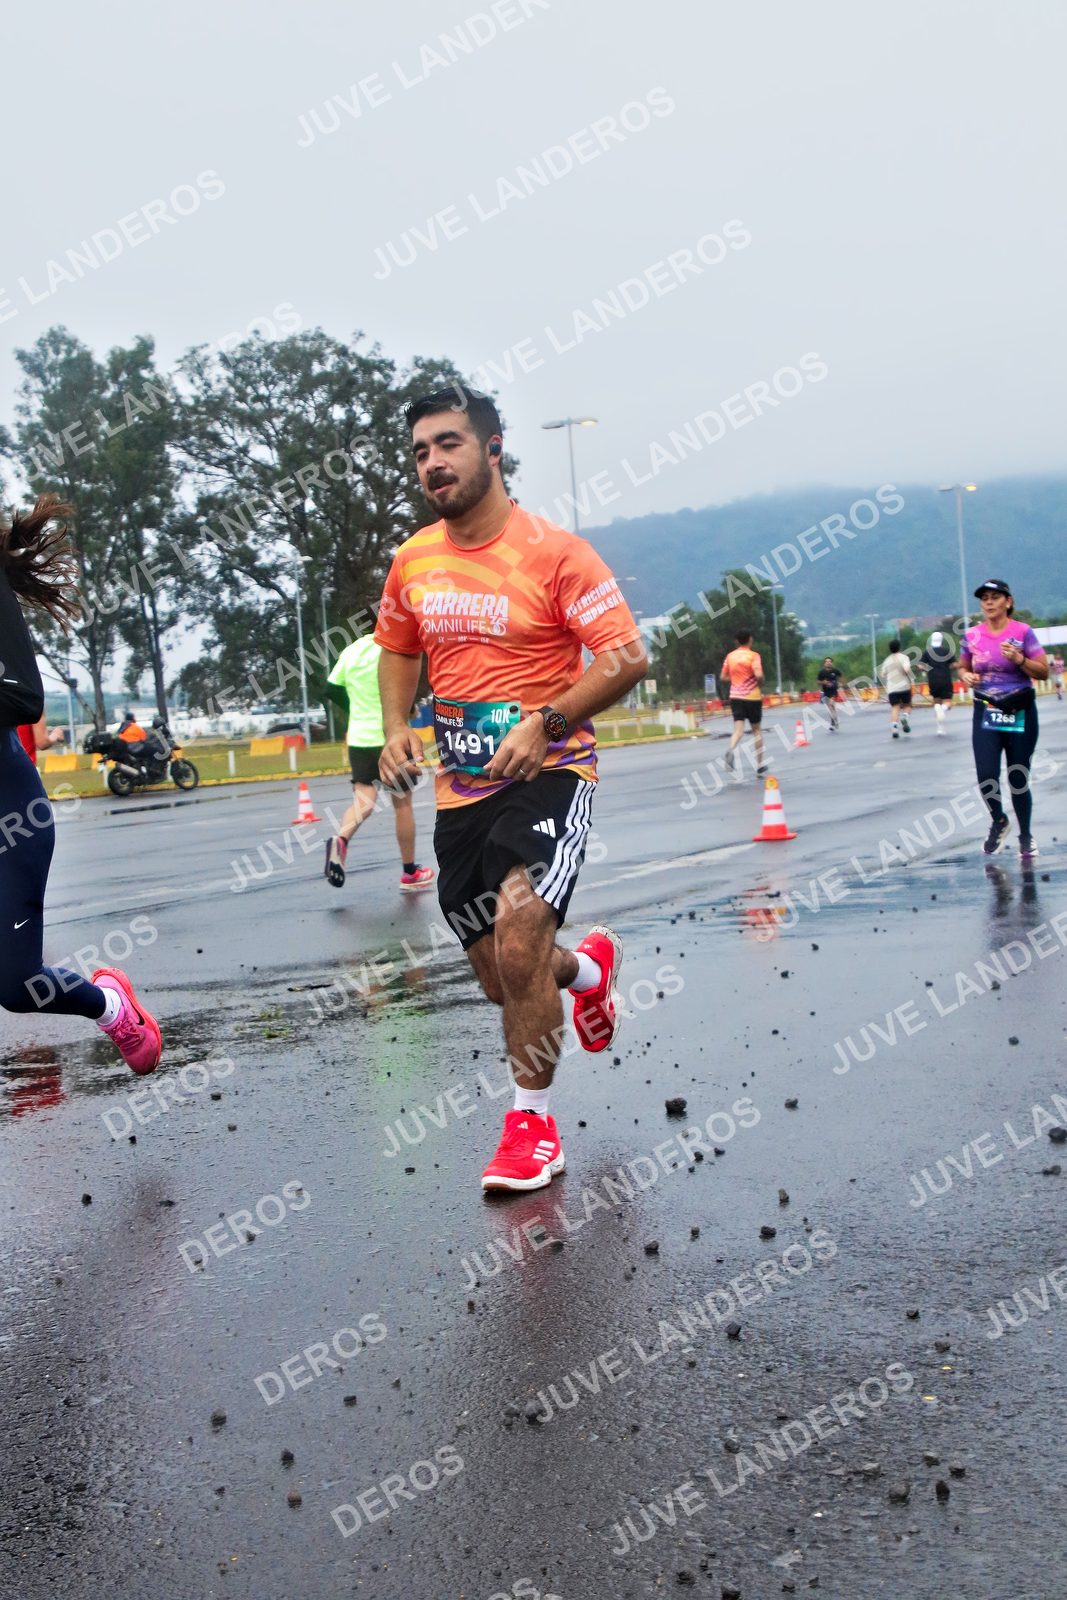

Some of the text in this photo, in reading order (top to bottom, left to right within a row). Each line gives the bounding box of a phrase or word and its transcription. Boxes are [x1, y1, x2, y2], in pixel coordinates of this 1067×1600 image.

[422, 591, 509, 617] CARRERA
[422, 618, 487, 634] OMNILIFE
[490, 708, 509, 723] 10K
[990, 712, 1016, 723] 1268
[444, 730, 495, 756] 1491
